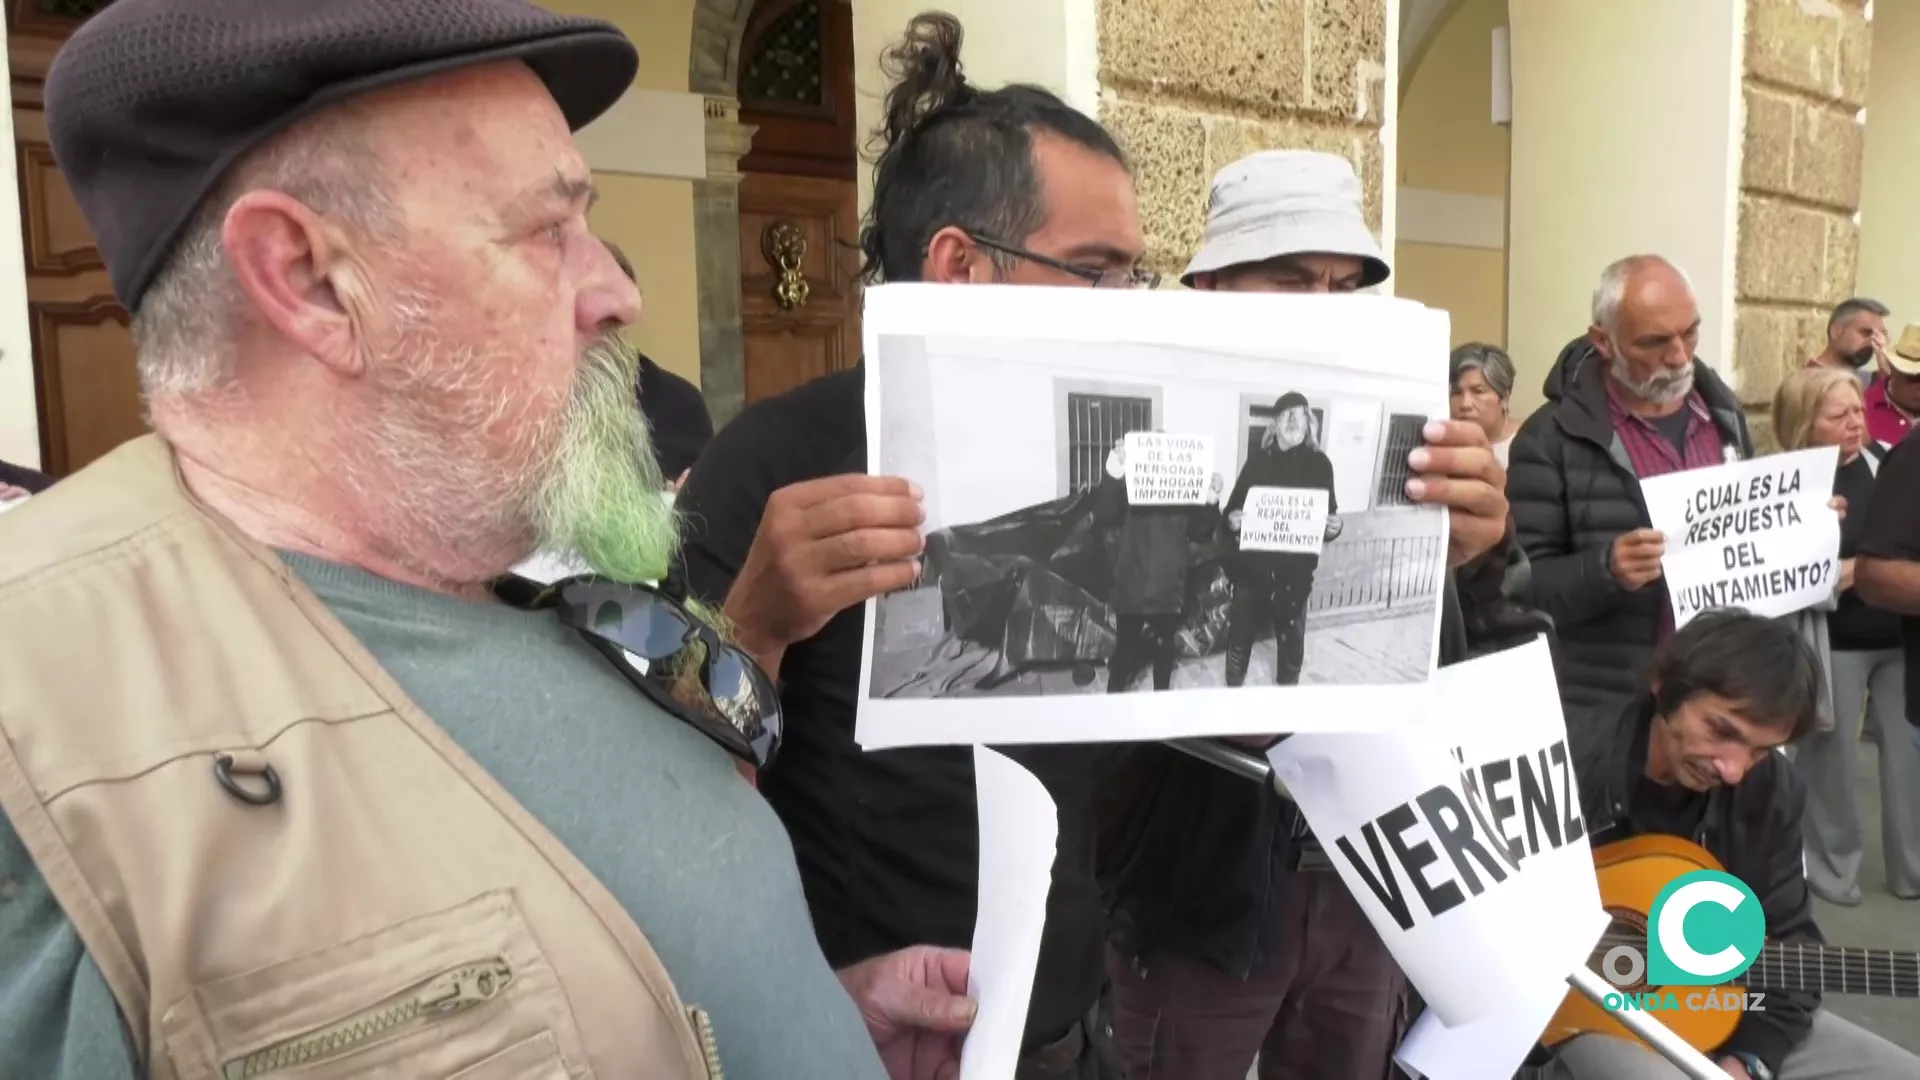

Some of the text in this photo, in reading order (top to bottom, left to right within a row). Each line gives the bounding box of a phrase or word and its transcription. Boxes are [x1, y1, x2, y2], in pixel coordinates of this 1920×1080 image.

[1137, 436, 1204, 451] LAS VIDAS
[1148, 451, 1193, 462] DE LAS
[1135, 463, 1204, 476] PERSONAS
[1133, 476, 1203, 488] SIN HOGAR
[1134, 488, 1200, 501] IMPORTAN
[1684, 468, 1801, 524] ¿CUAL ES LA
[1288, 495, 1300, 507] ES
[1302, 496, 1314, 508] LA
[1257, 507, 1312, 521] RESPUESTA
[1273, 521, 1290, 533] DEL
[1684, 501, 1803, 547] RESPUESTA
[1243, 531, 1320, 545] AYUNTAMIENTO?
[1723, 541, 1766, 571] DEL
